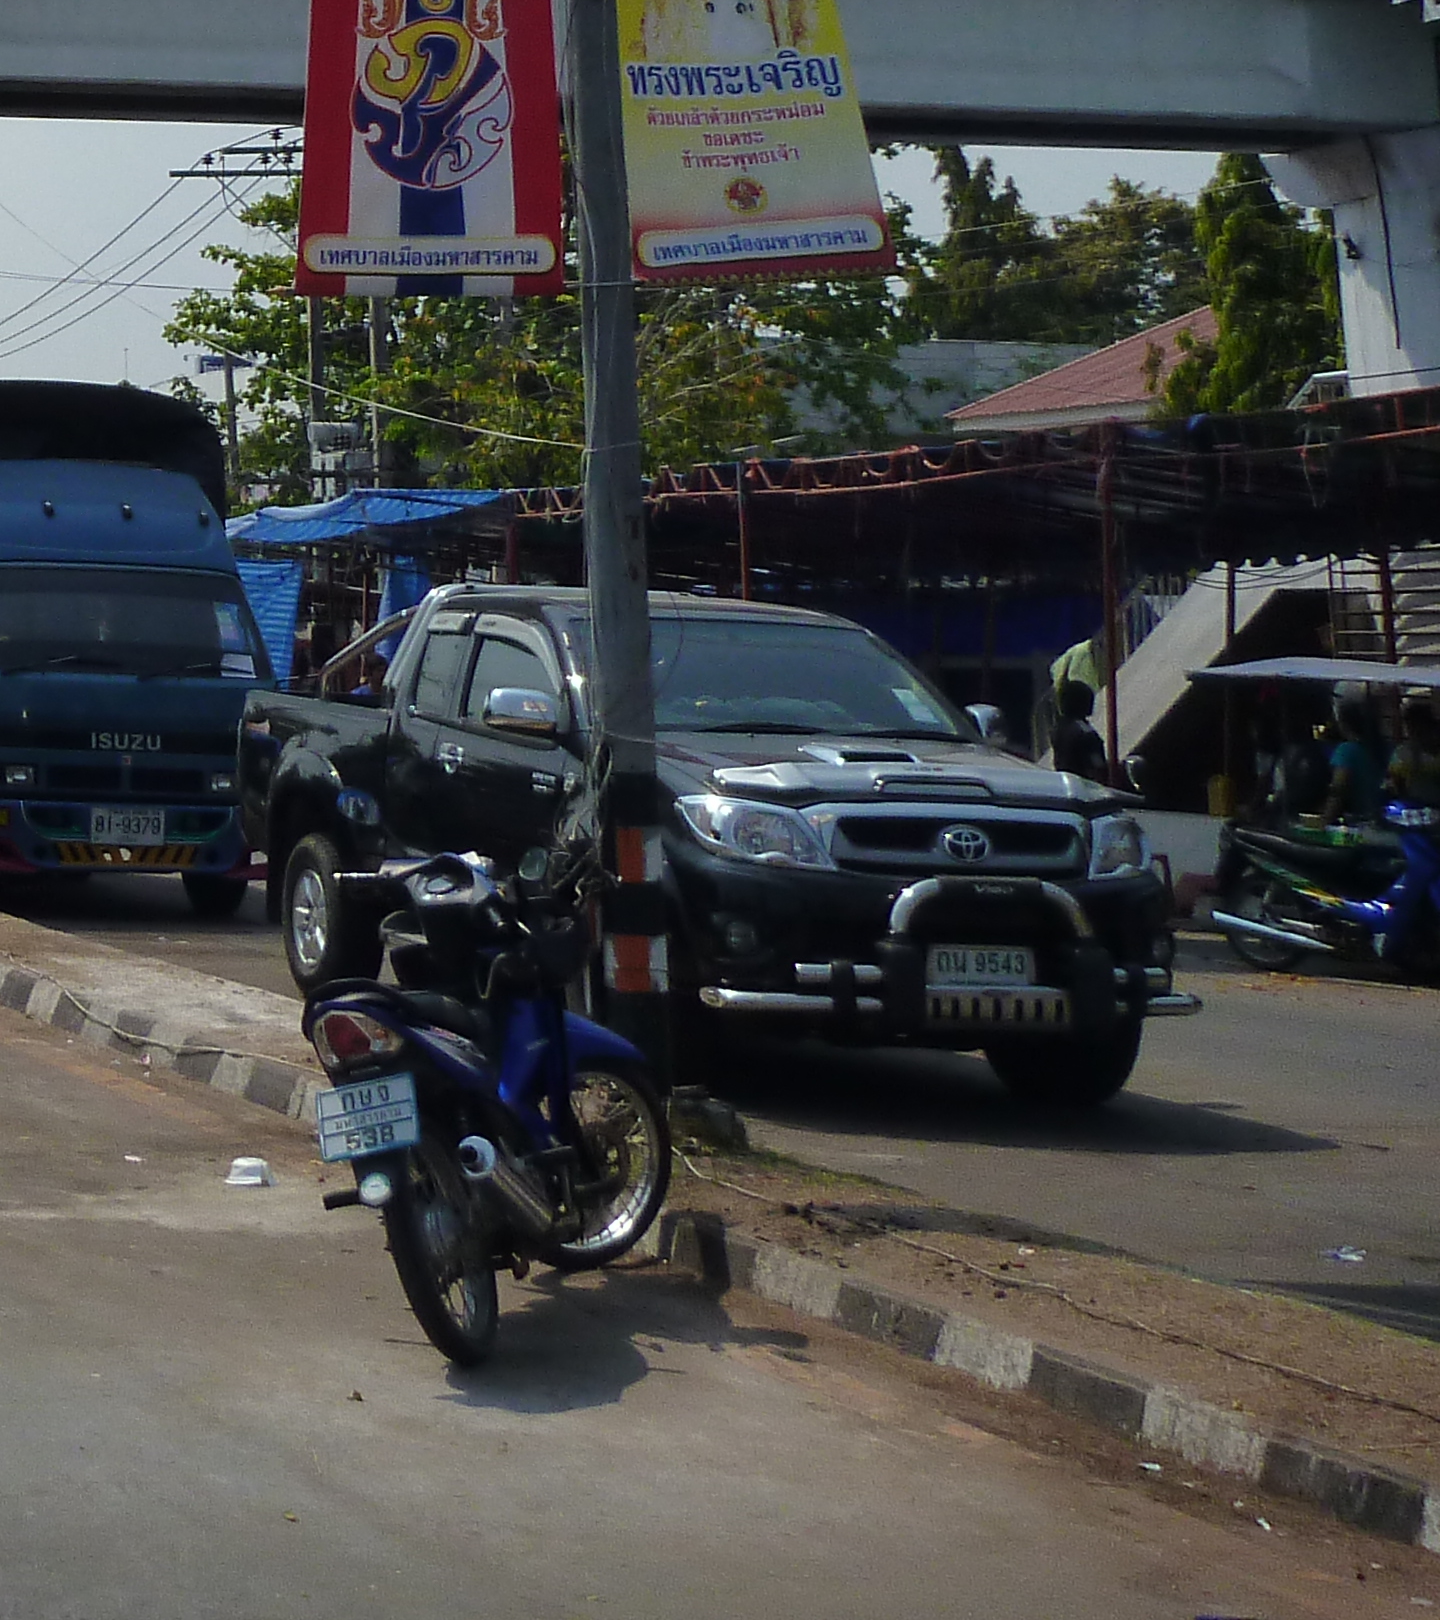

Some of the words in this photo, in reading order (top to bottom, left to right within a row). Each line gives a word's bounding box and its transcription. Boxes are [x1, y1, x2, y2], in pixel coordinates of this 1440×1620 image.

[626, 47, 842, 98] ทรงพระเจริญ
[702, 129, 764, 147] ขอเดชะ
[682, 143, 800, 172] ข้าพระพุทธเจ้า
[319, 245, 539, 267] เทศบาลเมืองมหาสารคาม
[652, 229, 868, 262] เทศบาลเมืองมหาสารคาม
[90, 730, 162, 751] ISUZU
